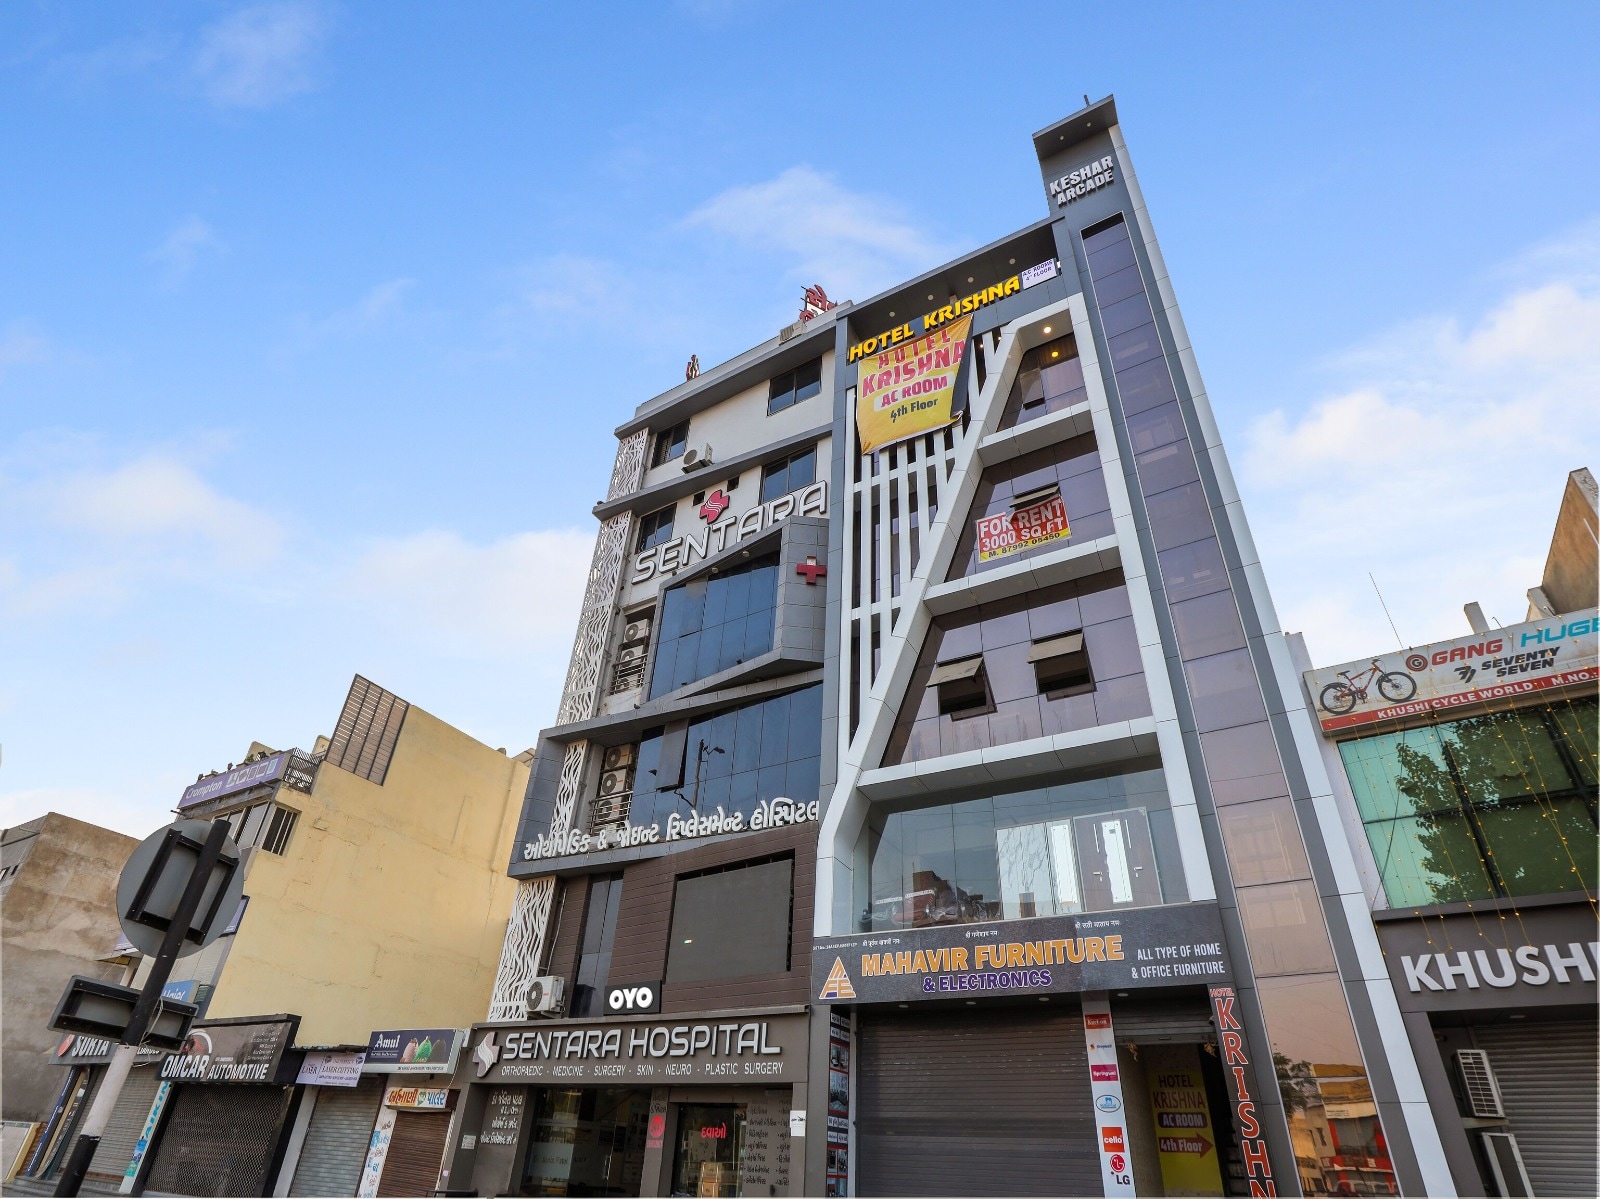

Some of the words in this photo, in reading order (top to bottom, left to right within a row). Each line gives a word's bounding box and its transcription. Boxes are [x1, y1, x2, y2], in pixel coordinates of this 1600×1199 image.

[1049, 155, 1114, 197] KESHAR
[1057, 169, 1114, 206] ARCADE
[848, 322, 915, 363] HOTEL
[923, 275, 1021, 330] KRISHNA
[878, 328, 952, 369] HOTEL
[862, 340, 966, 399] KRISHNA
[880, 389, 899, 408] AC
[901, 375, 948, 399] ROOM
[890, 404, 909, 424] 4th
[910, 398, 939, 413] Floor
[631, 479, 827, 585] SENTARA
[980, 516, 1014, 539] FOR
[1016, 500, 1062, 529] RENT
[982, 530, 1016, 552] 3000
[1020, 516, 1064, 540] SQ.FT
[1001, 541, 1029, 554] 87992
[1431, 638, 1503, 667] GANG
[1481, 646, 1561, 671] SEVENTY
[1496, 657, 1555, 678] SEVEN
[1378, 702, 1430, 719] KHUSHI
[1432, 692, 1477, 708] CYCLE
[1478, 682, 1534, 702] WORLD
[185, 780, 223, 799] Crompton
[861, 945, 969, 977] MAHAVIR
[974, 934, 1125, 971] FURNITURE
[1137, 948, 1154, 961] ALL
[1156, 946, 1178, 959] TYPE
[1180, 945, 1192, 958] OF
[1194, 942, 1222, 956] HOME
[923, 976, 935, 993] &
[938, 968, 1052, 992] ELECTRONICS
[1131, 967, 1139, 979] &
[1140, 964, 1171, 979] OFFICE
[1173, 961, 1225, 977] FURNITURE
[608, 985, 654, 1010] OYO
[1209, 987, 1235, 998] HOTEL
[374, 1033, 401, 1050] Amul
[502, 1028, 623, 1061] SENTARA
[628, 1022, 782, 1058] HOSPITAL
[161, 1054, 210, 1079] OMCAR
[207, 1062, 269, 1080] AUTOMOTIVE
[501, 1064, 544, 1077] ORTHOPAEDIC
[552, 1064, 584, 1077] MEDICINE
[593, 1064, 627, 1077] SURGERY
[636, 1063, 655, 1076] SKIN
[665, 1063, 693, 1076] NEURO
[704, 1062, 739, 1076] PLASTIC
[743, 1061, 785, 1075] SURGERY
[1158, 1074, 1194, 1089] HOTEL
[1153, 1090, 1207, 1110] KRISHNA
[701, 1122, 728, 1139] દવાઓ
[1162, 1113, 1176, 1126] AC
[1176, 1112, 1204, 1126] ROOM
[1103, 1135, 1123, 1144] cello
[1160, 1138, 1177, 1151] 4th
[1178, 1138, 1203, 1152] Floor
[1116, 1174, 1131, 1185] LG
